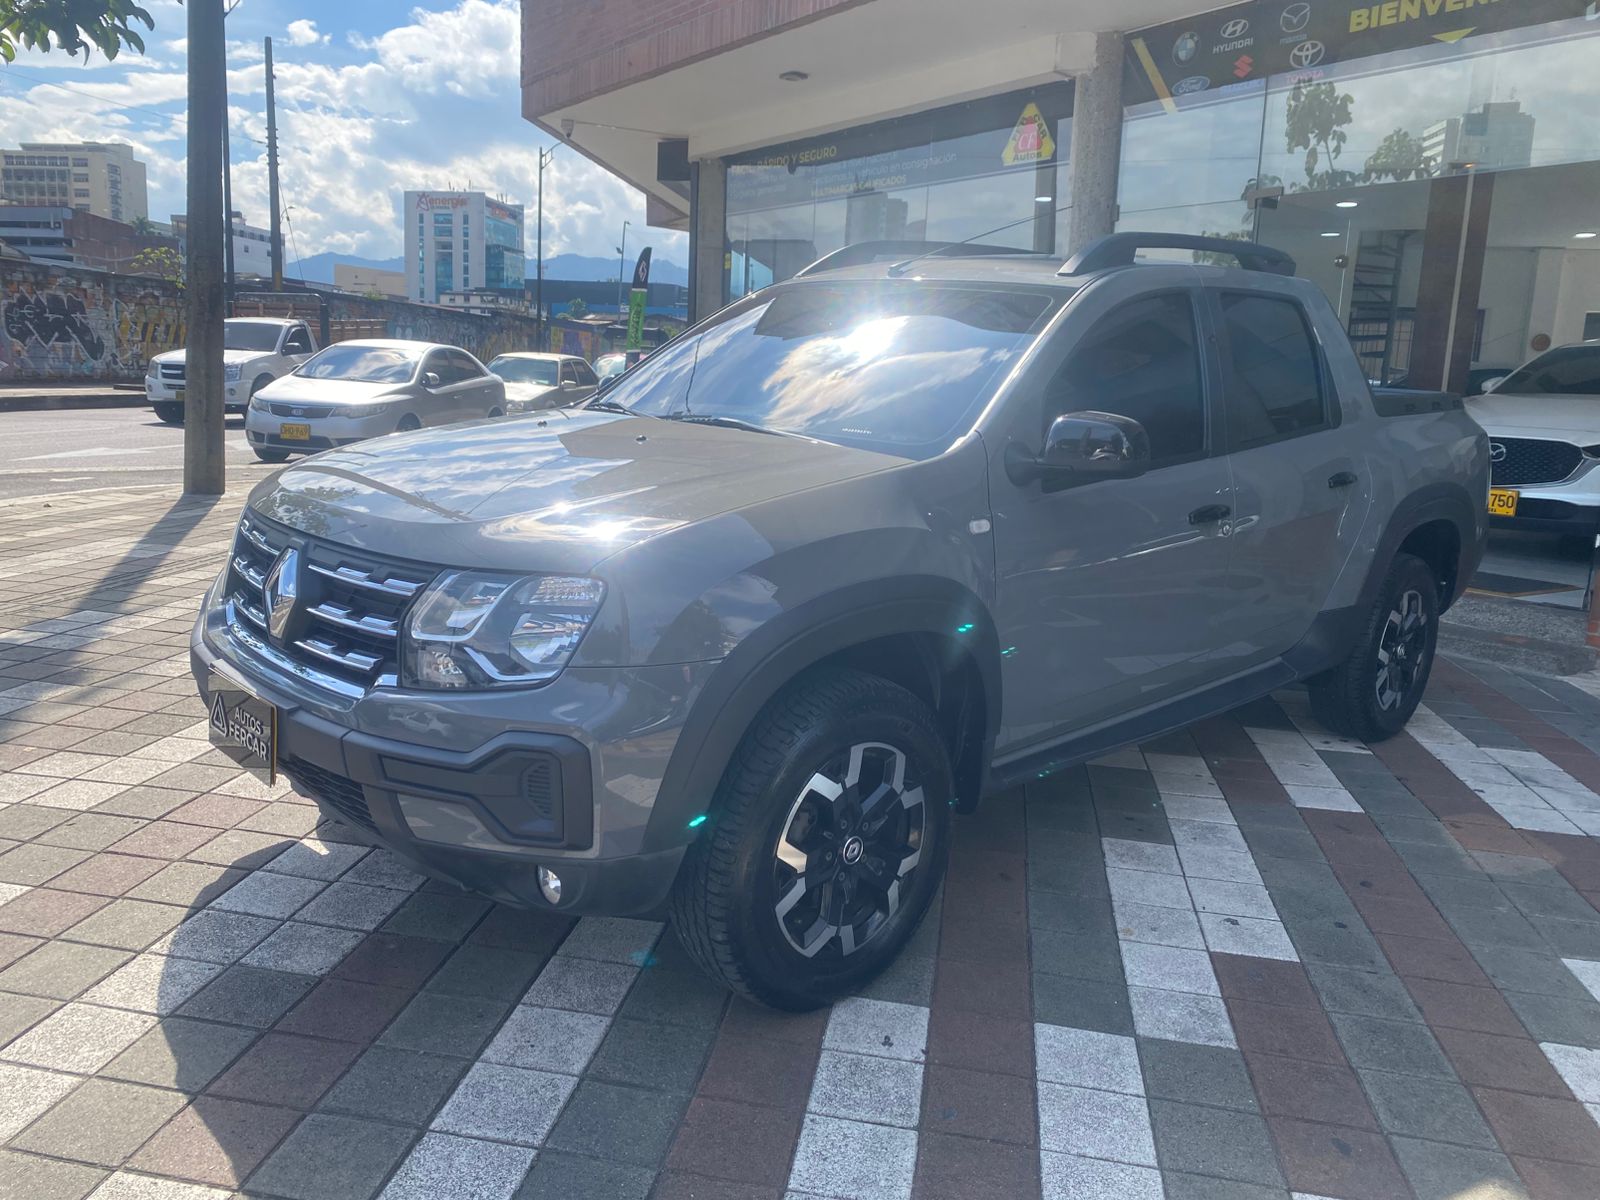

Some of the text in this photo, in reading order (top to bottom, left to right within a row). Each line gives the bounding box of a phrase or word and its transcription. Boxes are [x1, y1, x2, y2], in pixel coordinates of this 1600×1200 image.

[1212, 37, 1254, 55] HYUNDAI
[791, 153, 798, 164] Y
[799, 145, 837, 163] SEGURO
[1490, 493, 1515, 509] 750
[234, 707, 261, 735] AUTOS
[229, 720, 267, 761] FERCAR
